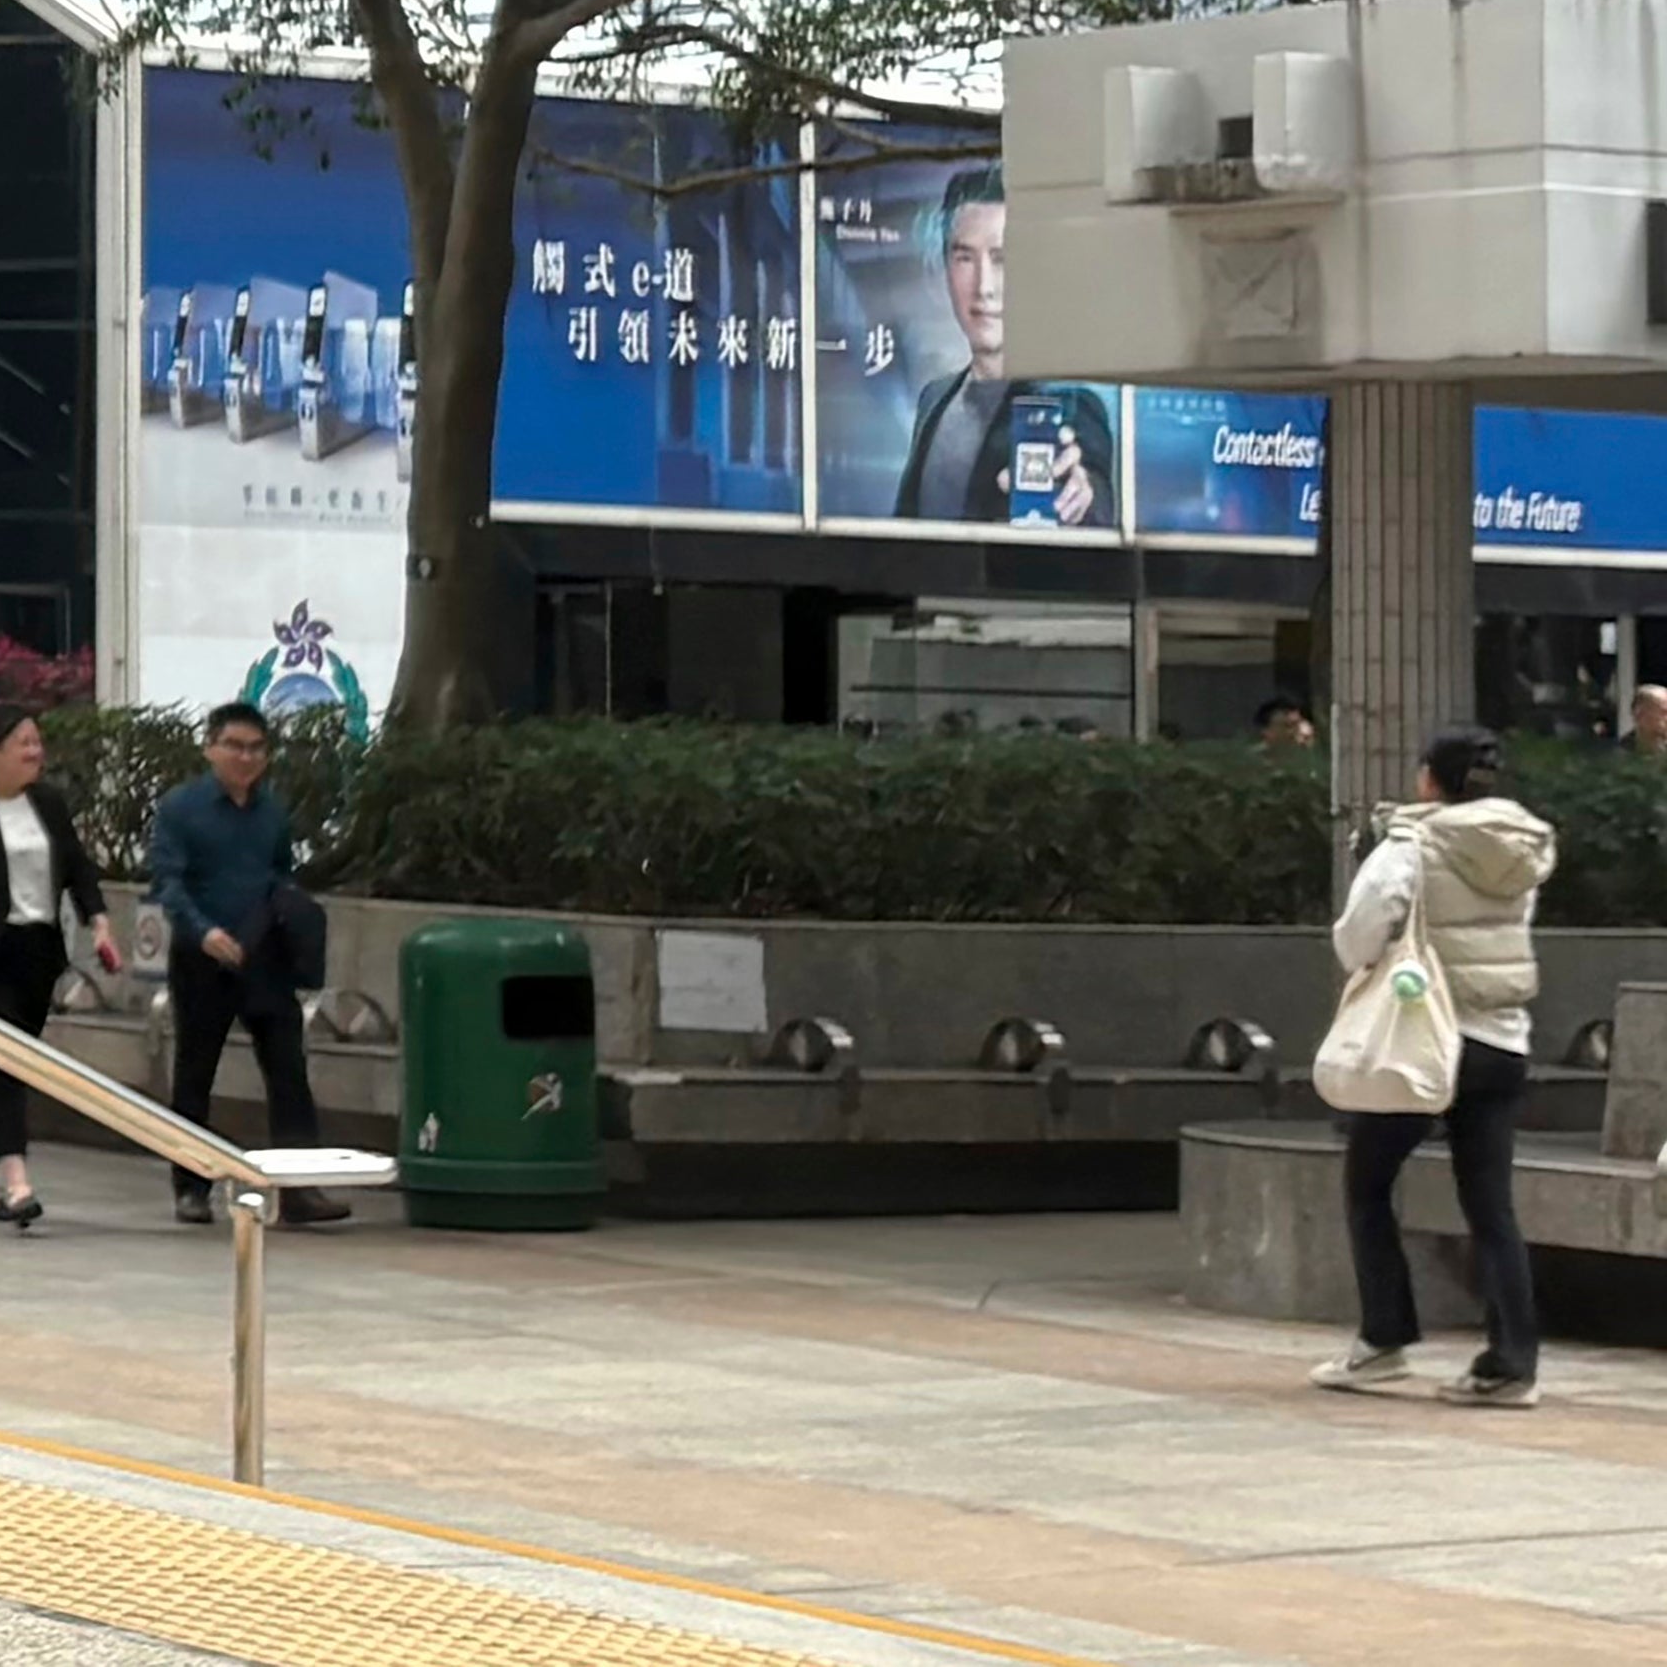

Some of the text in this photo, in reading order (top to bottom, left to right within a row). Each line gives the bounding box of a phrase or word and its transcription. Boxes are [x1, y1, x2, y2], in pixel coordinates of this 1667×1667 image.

[1213, 422, 1319, 468] Contactless
[1473, 492, 1493, 528] to
[1496, 485, 1525, 529] the
[1527, 491, 1583, 533] Future
